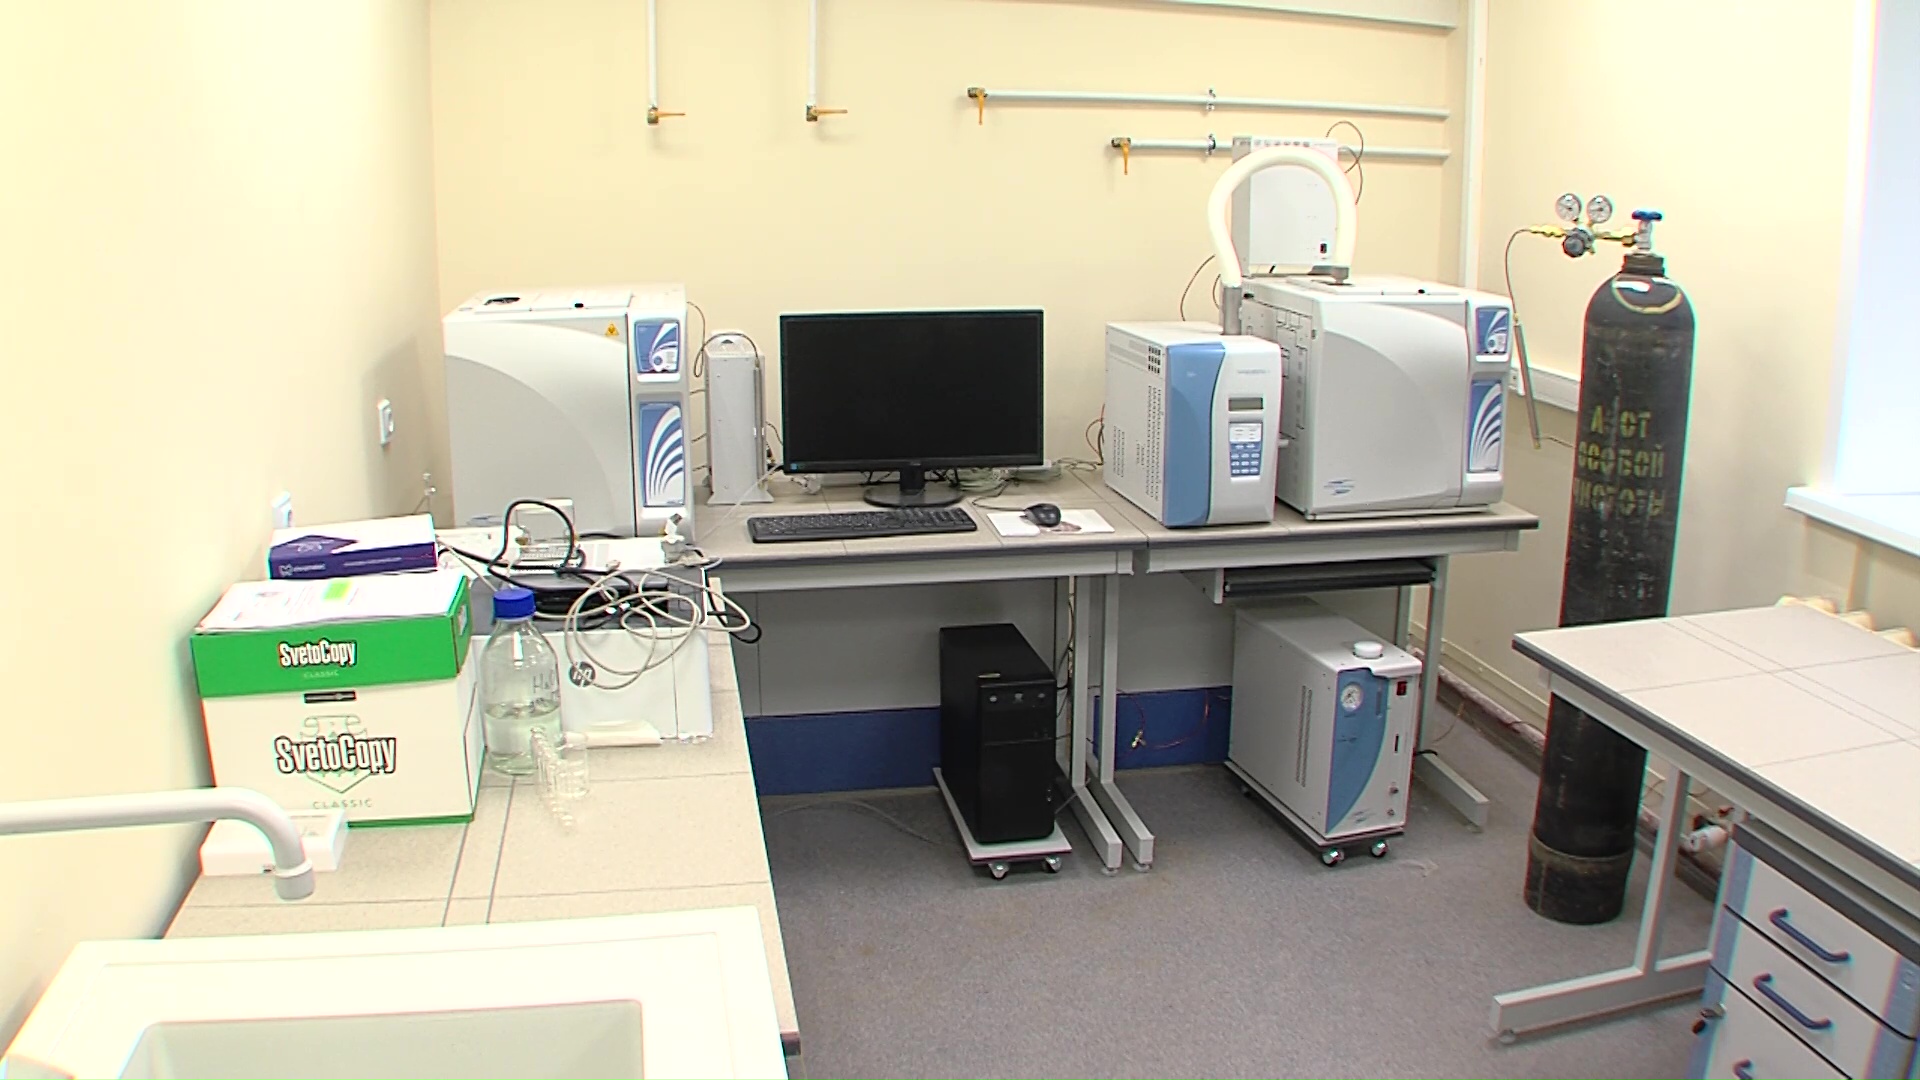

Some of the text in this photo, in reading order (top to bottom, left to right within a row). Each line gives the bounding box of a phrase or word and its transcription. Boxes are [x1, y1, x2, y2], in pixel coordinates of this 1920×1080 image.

[278, 638, 357, 668] SvetoCopy
[303, 669, 340, 679] CLASSIC
[274, 733, 397, 775] SvetoCopy
[312, 797, 373, 810] CLASSIC
